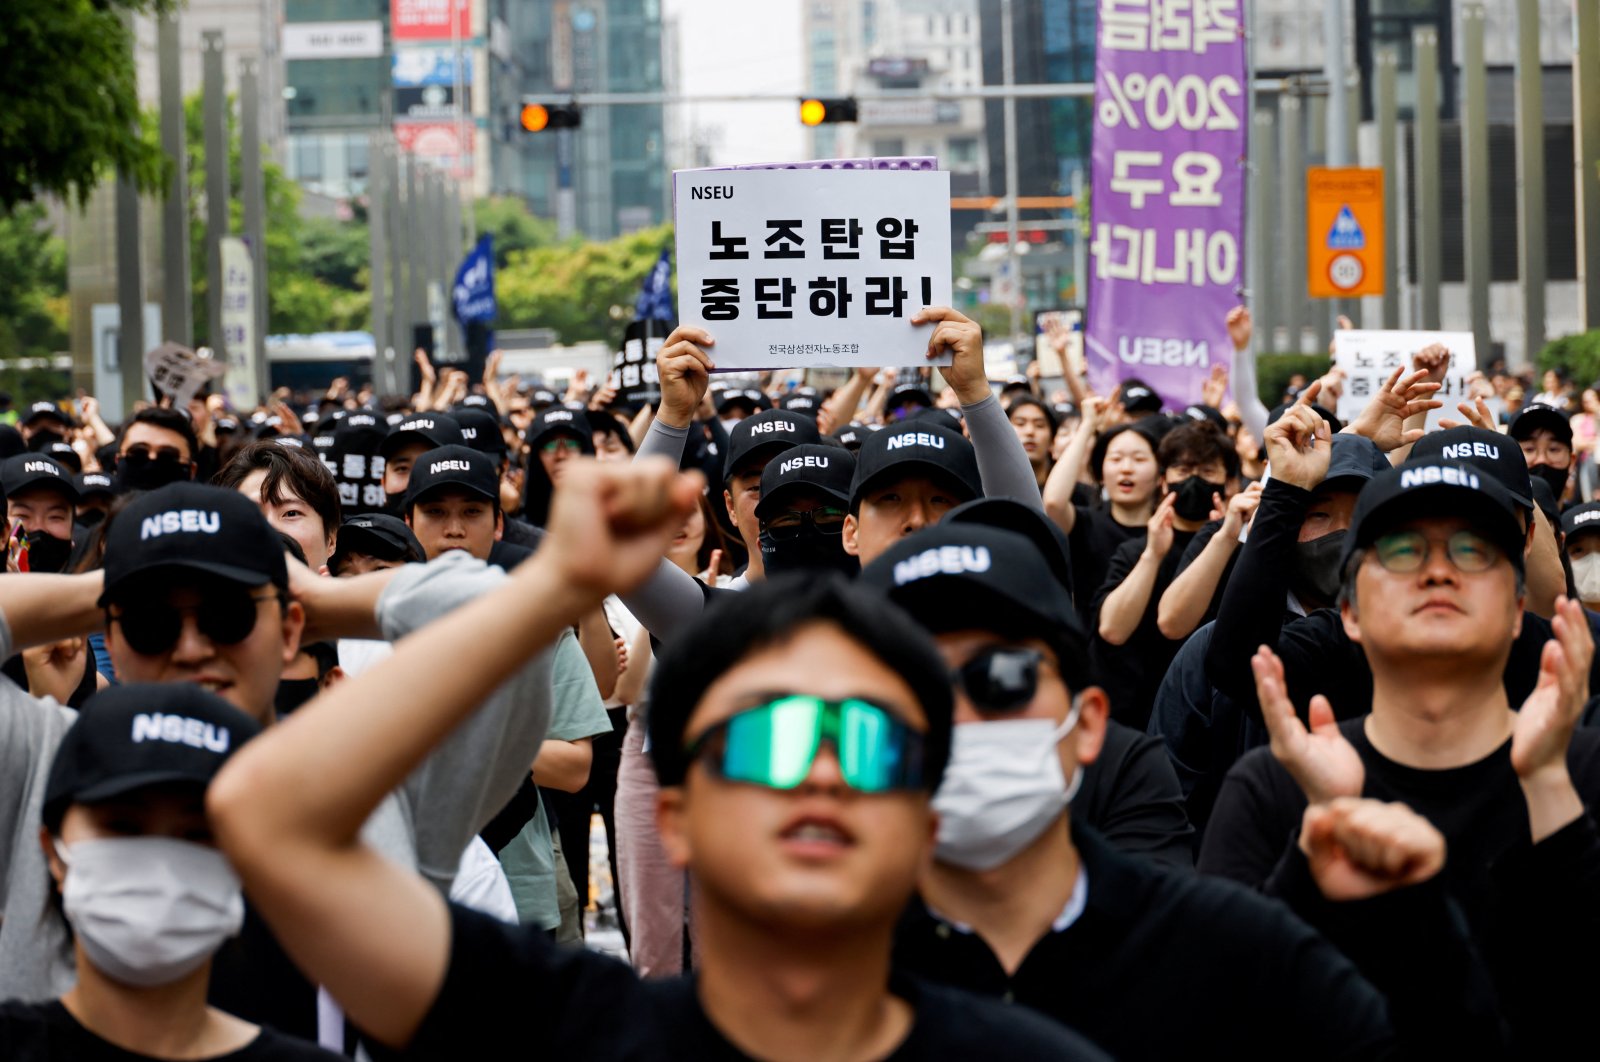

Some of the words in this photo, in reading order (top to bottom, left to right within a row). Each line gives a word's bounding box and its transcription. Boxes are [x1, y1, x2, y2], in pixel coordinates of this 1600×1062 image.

[691, 186, 734, 200] NSEU
[709, 217, 919, 260] 노조탄압
[700, 276, 932, 321] 중단하라!
[768, 343, 860, 355] 전국삼성전자노동조합
[751, 420, 795, 437] NSEU
[887, 432, 945, 450] NSEU
[1442, 442, 1499, 460] NSEU
[25, 461, 59, 476] NSEU
[430, 460, 470, 474] NSEU
[780, 456, 829, 475] NSEU
[141, 509, 220, 540] NSEU
[894, 545, 991, 586] NSEU
[132, 711, 230, 753] NSEU
